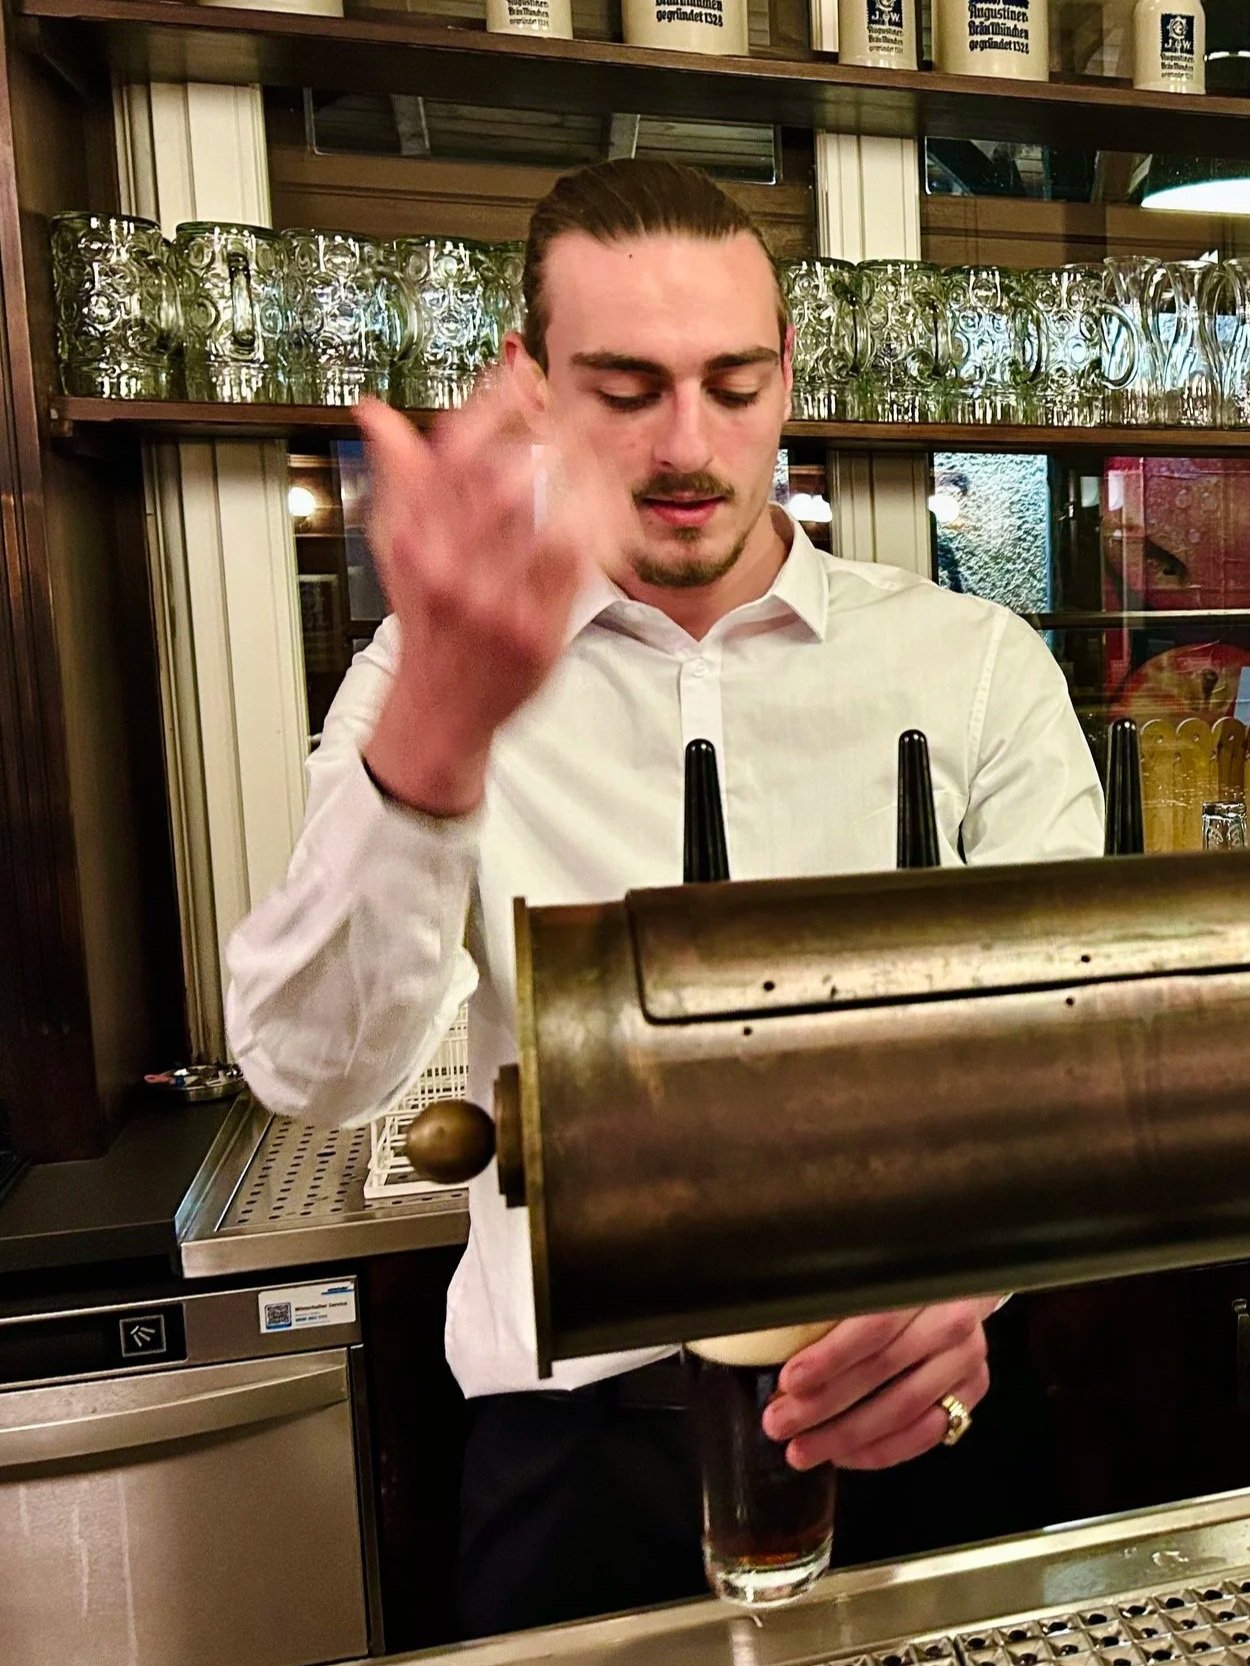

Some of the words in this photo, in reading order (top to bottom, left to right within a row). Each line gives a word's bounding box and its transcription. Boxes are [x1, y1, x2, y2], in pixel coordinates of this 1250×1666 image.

[656, 8, 703, 22] gegründet
[704, 12, 723, 27] 1328
[969, 38, 1012, 51] gegründet
[1013, 41, 1029, 54] 1328
